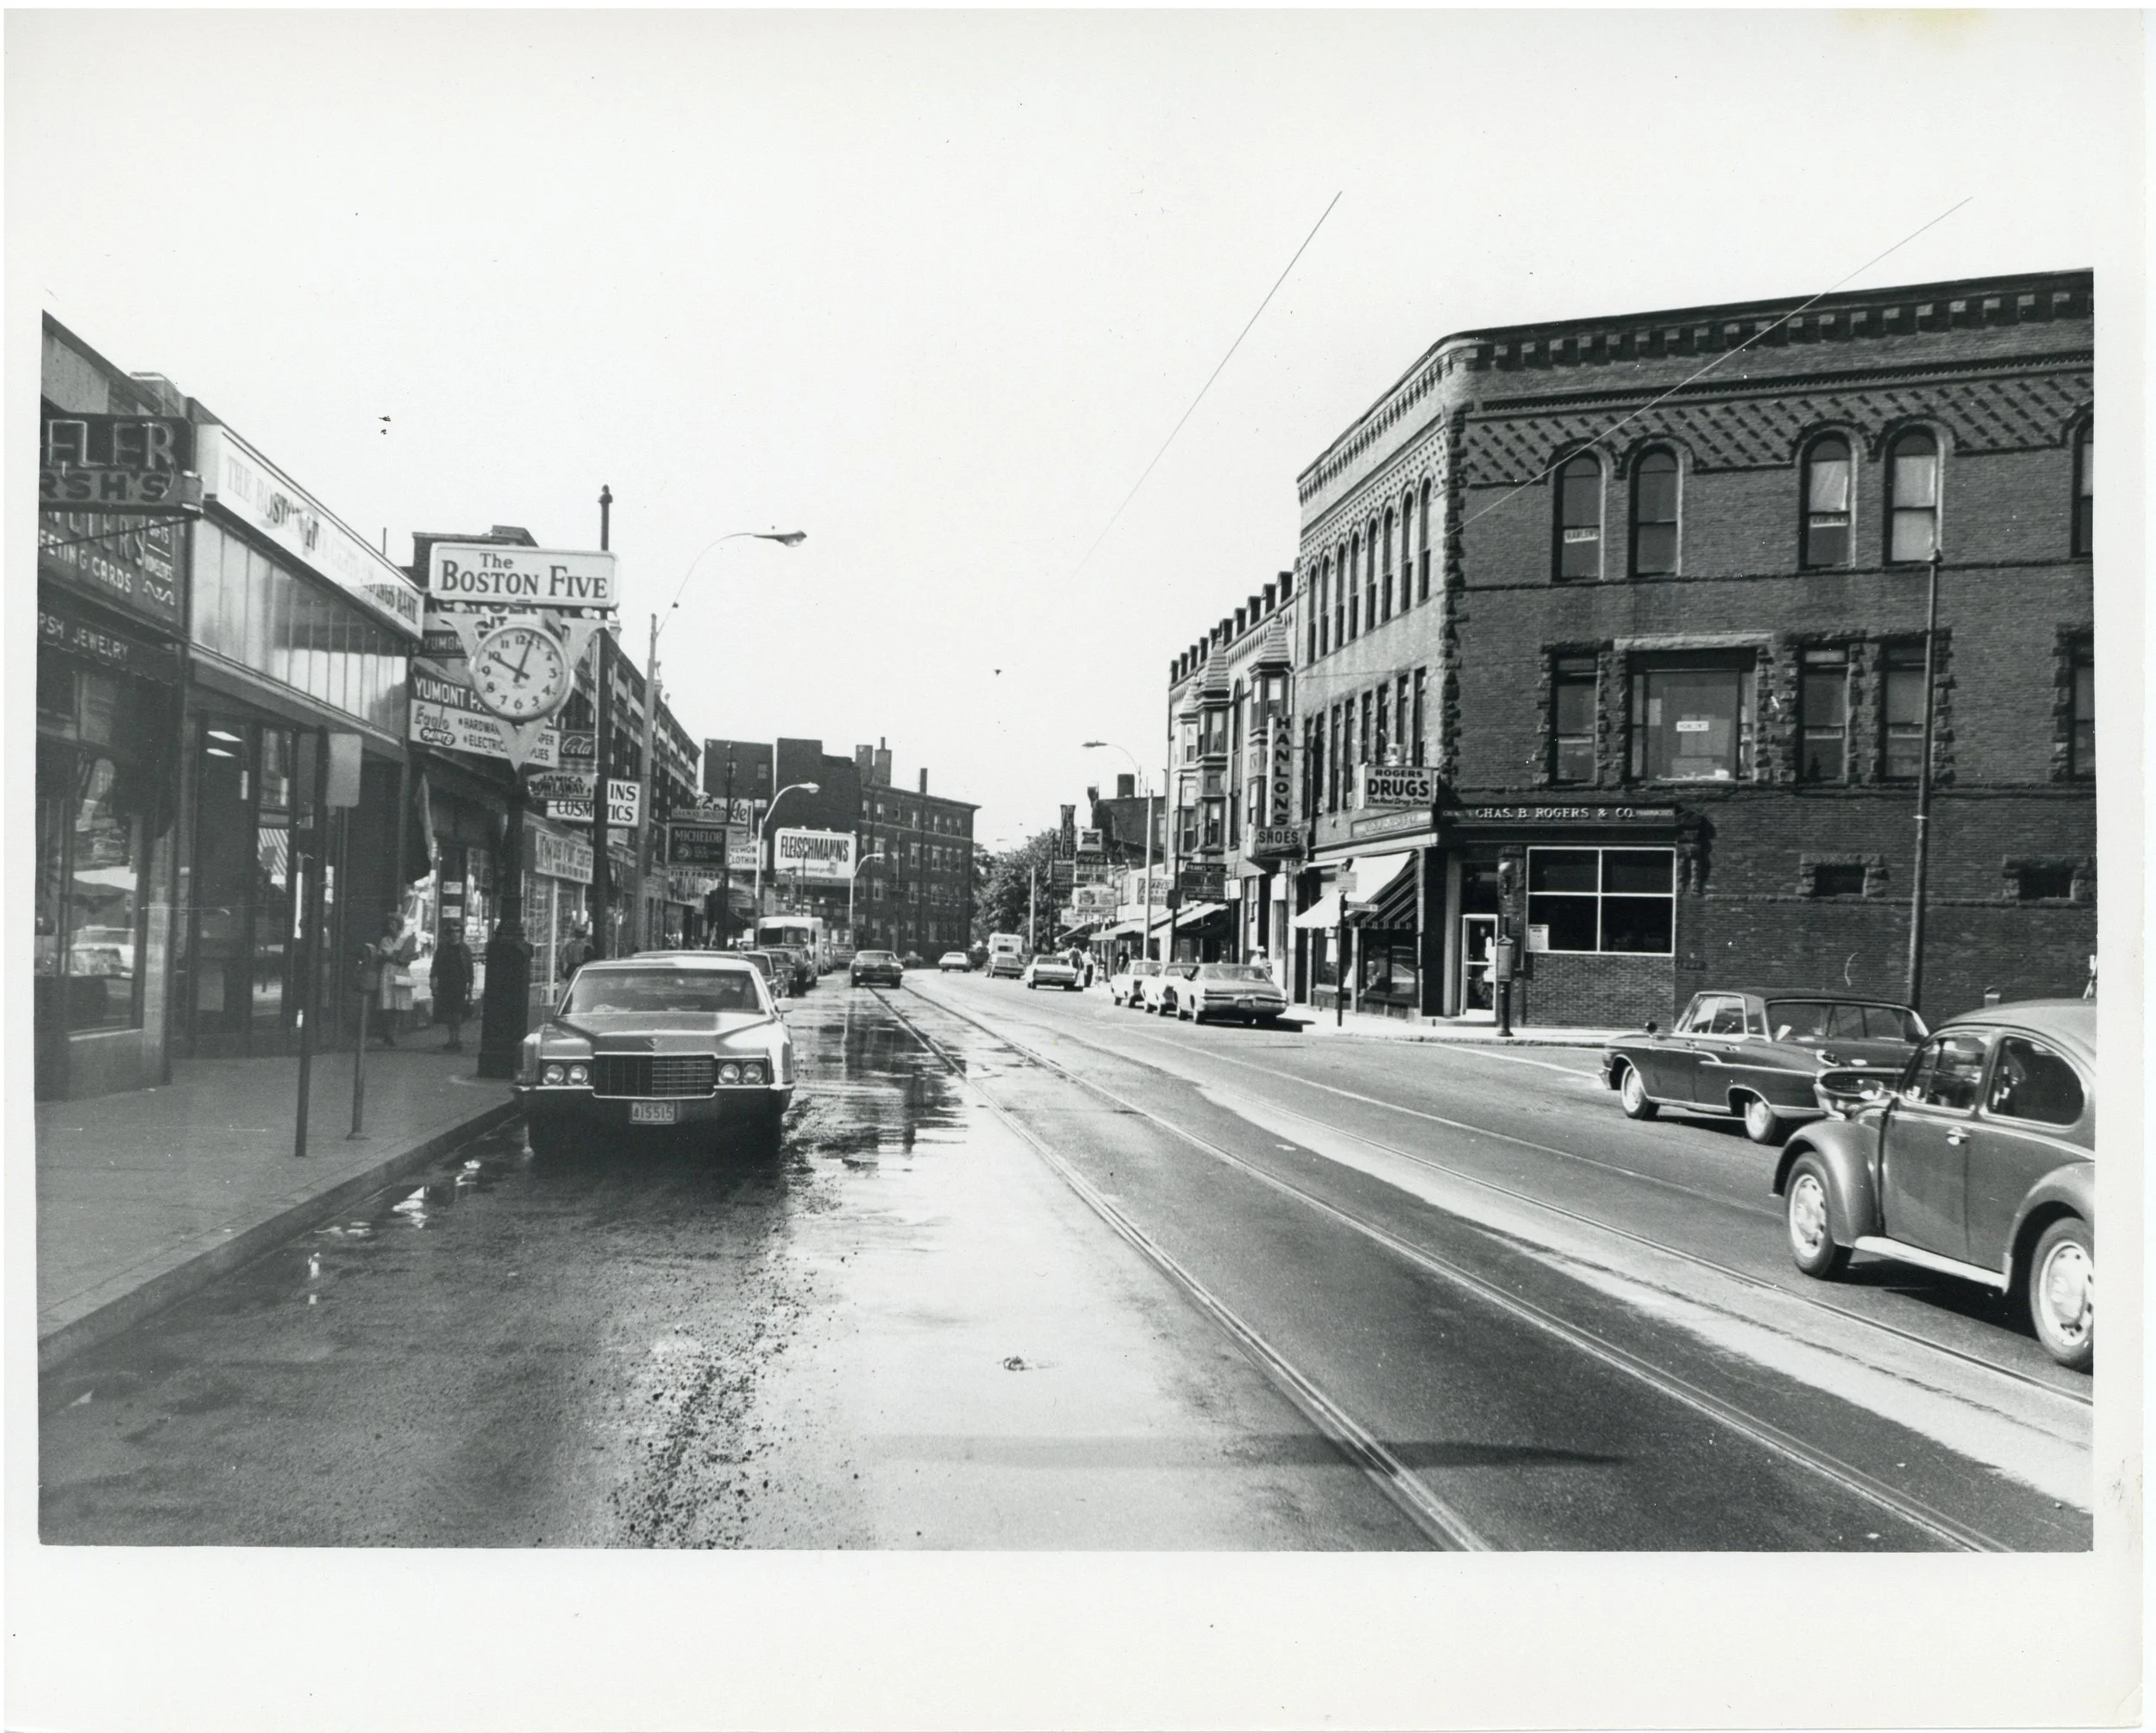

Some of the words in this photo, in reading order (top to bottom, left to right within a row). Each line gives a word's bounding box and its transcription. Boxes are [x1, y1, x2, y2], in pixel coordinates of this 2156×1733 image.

[479, 553, 514, 568] The
[91, 556, 132, 593] CARDS
[441, 560, 539, 596] BOSTON
[548, 565, 607, 599] FIVE
[500, 640, 511, 650] 11
[515, 634, 527, 645] 12
[488, 650, 501, 662] 10
[481, 666, 492, 676] 9
[548, 668, 557, 679] 3
[415, 677, 466, 706] YUMONT
[486, 681, 496, 694] 8
[542, 684, 552, 696] 4
[500, 694, 509, 706] 7
[514, 699, 523, 710] 6
[531, 695, 540, 707] 5
[561, 736, 592, 755] Cola
[1274, 717, 1290, 826] HANLONS
[1375, 769, 1423, 778] ROGERS
[1367, 779, 1429, 797] DRUGS
[1367, 796, 1379, 805] The
[1476, 807, 1514, 819] CHAS.
[1518, 808, 1530, 818] B.
[1535, 807, 1589, 819] ROGERS
[1597, 808, 1608, 818] &
[1615, 807, 1635, 819] CO.
[674, 831, 724, 844] MICHELOB
[1258, 830, 1299, 845] SHOES
